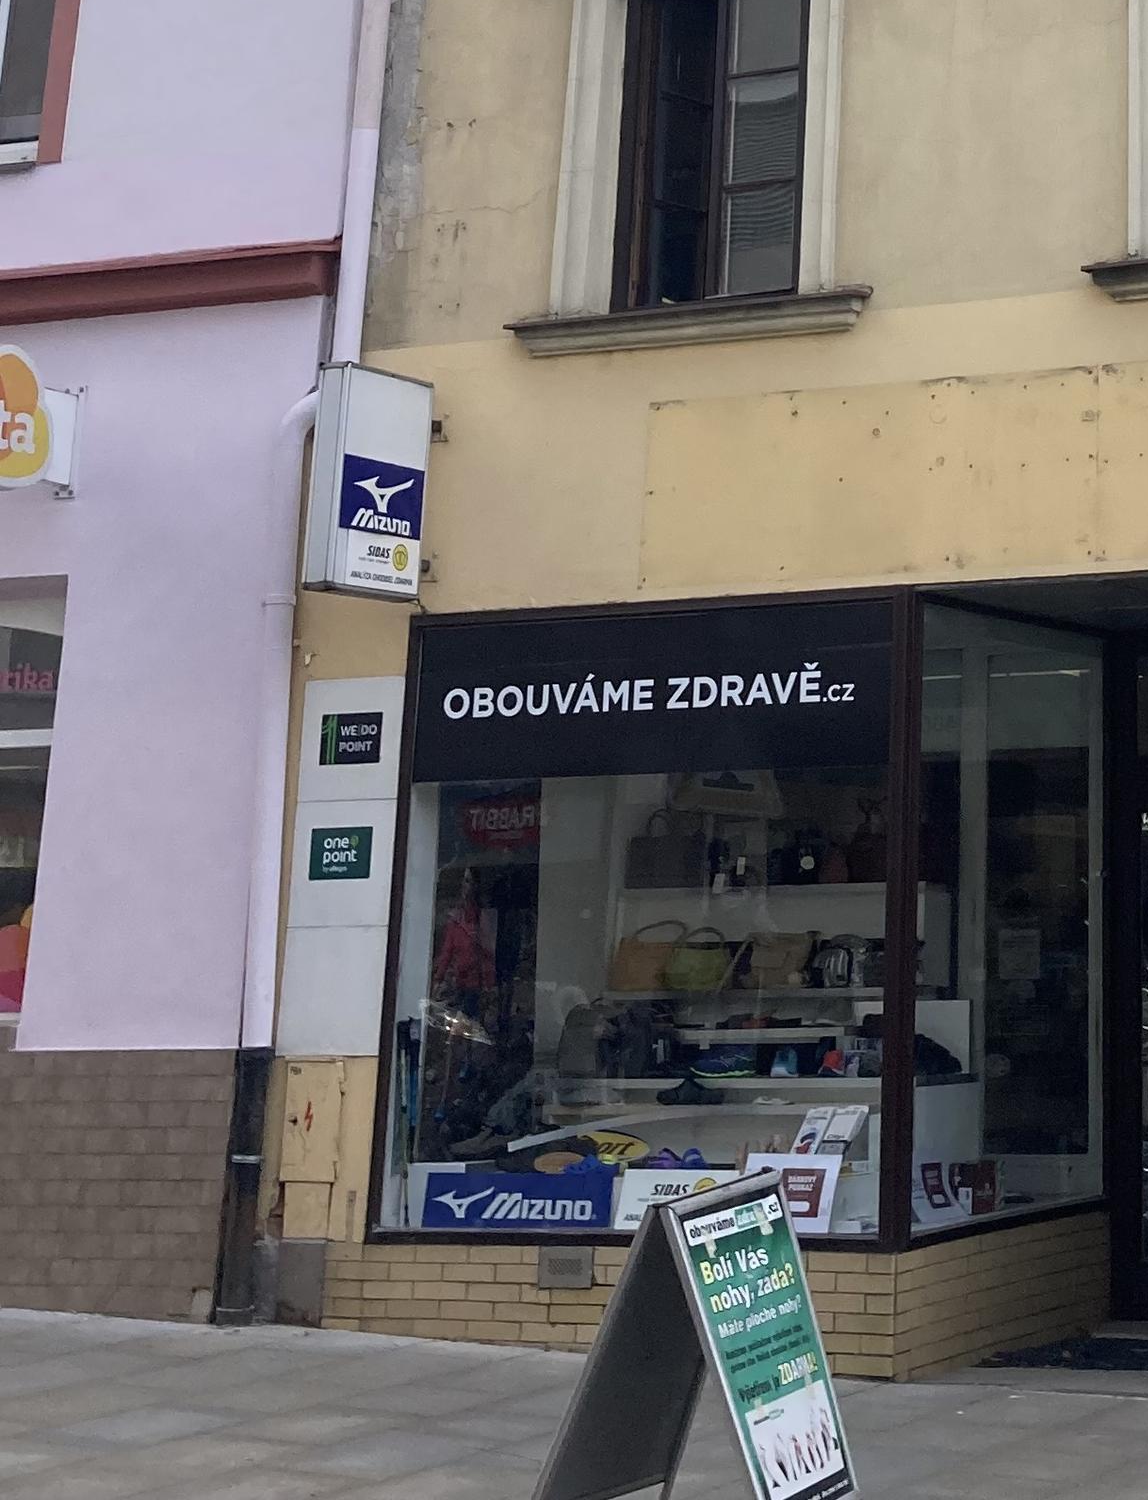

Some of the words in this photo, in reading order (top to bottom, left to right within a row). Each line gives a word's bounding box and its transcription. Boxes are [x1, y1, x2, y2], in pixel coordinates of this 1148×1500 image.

[366, 545, 391, 559] SIDAS
[443, 673, 655, 719] OBOUVÁME
[339, 741, 373, 752] POINT
[324, 837, 349, 849] one
[323, 849, 358, 864] point
[651, 1184, 689, 1196] SIDAS
[700, 1251, 734, 1284] Bolí
[736, 1245, 768, 1272] Vás
